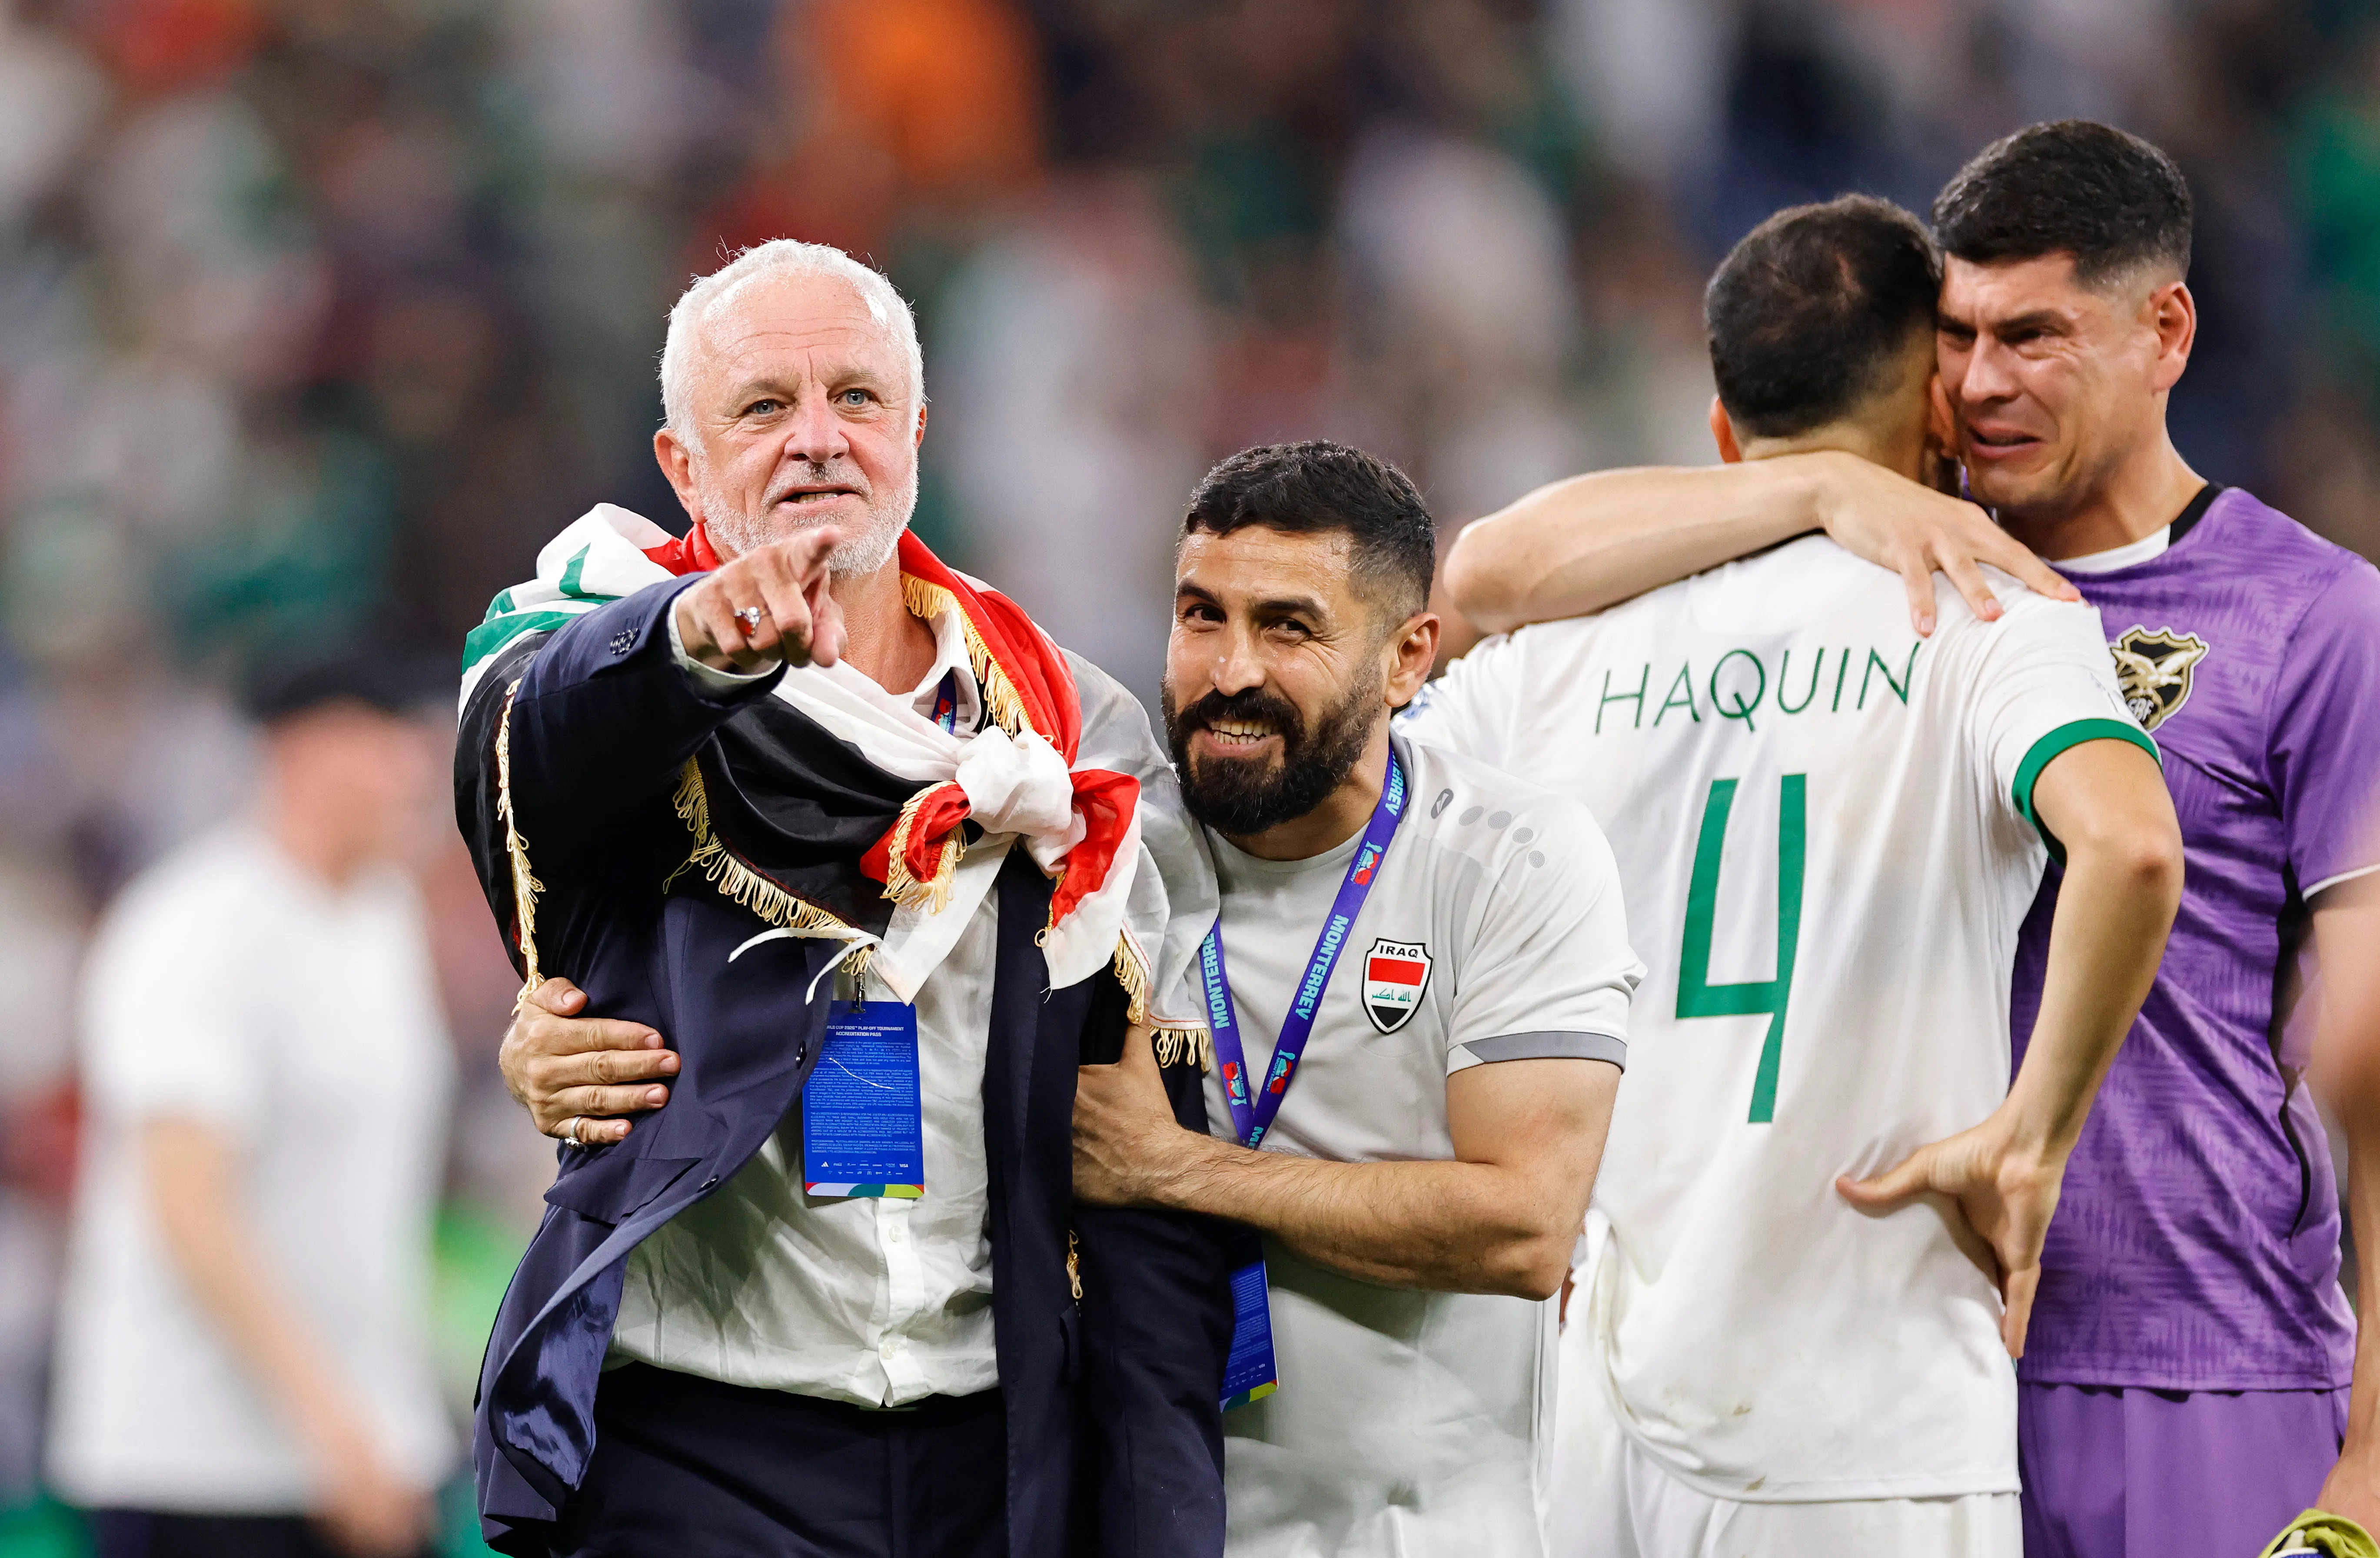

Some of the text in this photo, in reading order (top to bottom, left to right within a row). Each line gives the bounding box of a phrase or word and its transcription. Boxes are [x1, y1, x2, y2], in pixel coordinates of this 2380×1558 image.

[1595, 641, 1921, 735] HAQUIN
[1385, 751, 1403, 816] ERREY
[1202, 932, 1230, 1029] MONTERRE
[1295, 914, 1350, 1020] MONTERREY
[1379, 945, 1419, 958] IRAQ
[1675, 773, 1807, 1124] 4
